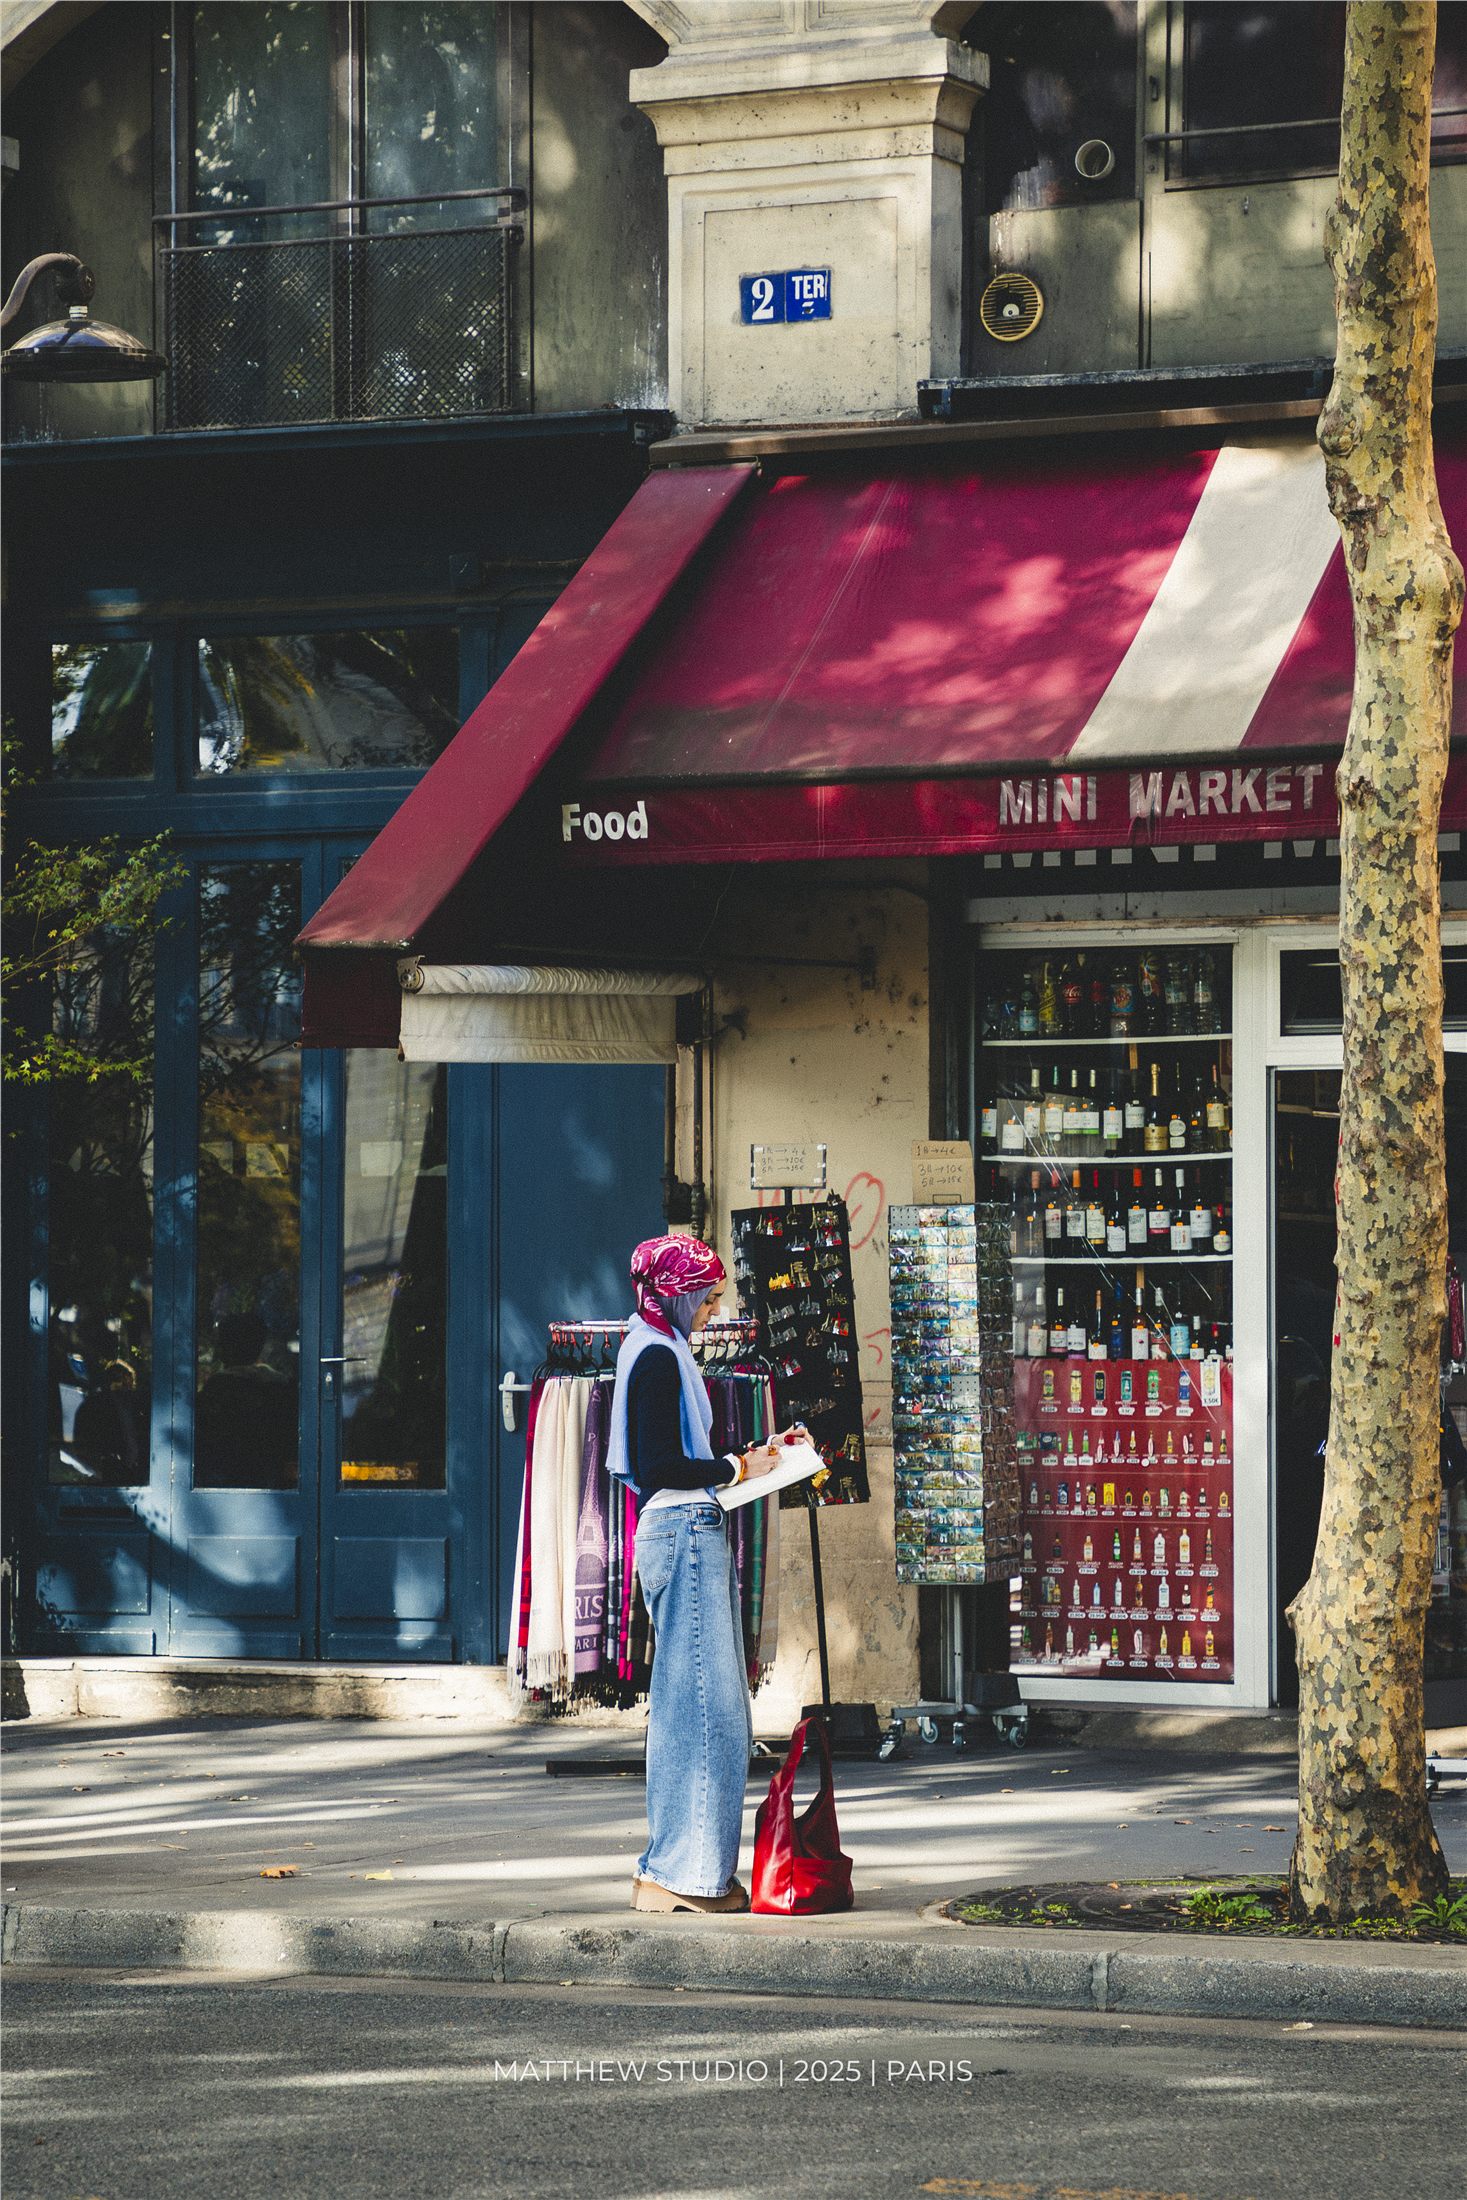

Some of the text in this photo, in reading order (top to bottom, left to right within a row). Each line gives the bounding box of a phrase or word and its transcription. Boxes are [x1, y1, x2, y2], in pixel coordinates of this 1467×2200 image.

[751, 274, 825, 320] 2 TER
[1000, 764, 1323, 825] MINI MARKET
[562, 801, 648, 842] Food
